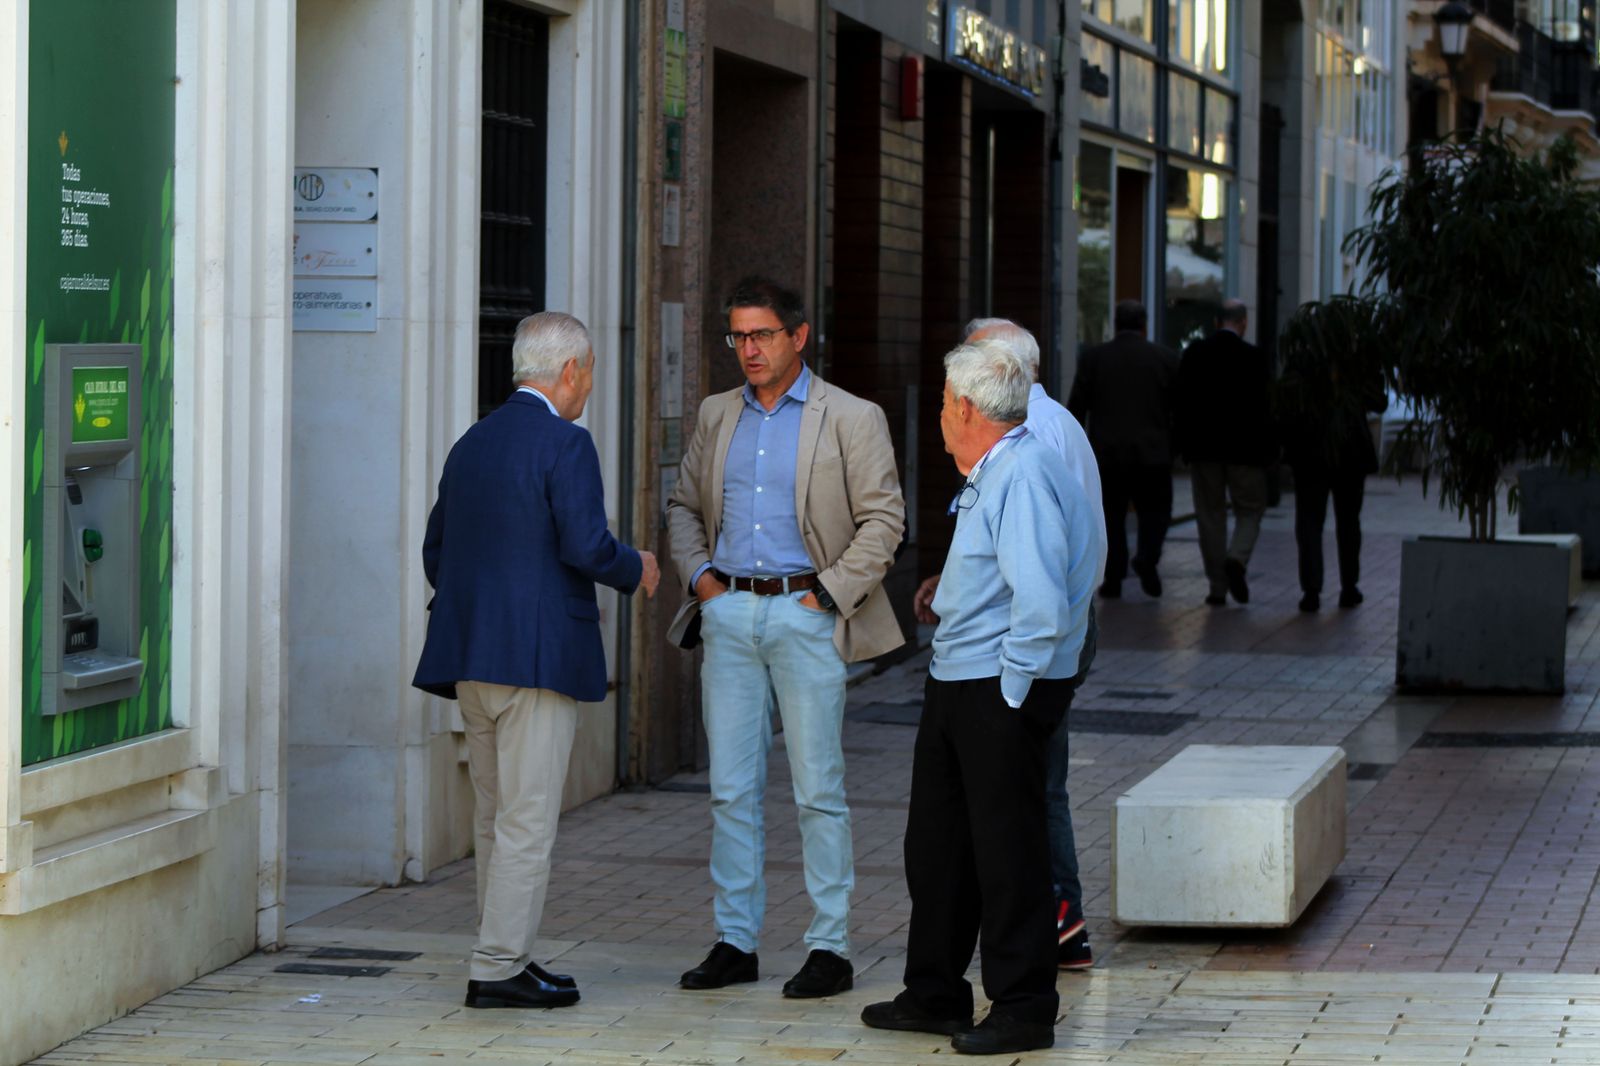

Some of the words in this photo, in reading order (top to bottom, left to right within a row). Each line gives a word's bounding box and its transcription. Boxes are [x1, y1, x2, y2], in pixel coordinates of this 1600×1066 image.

[62, 163, 80, 181] Todas
[61, 186, 72, 203] tus
[73, 187, 110, 208] operaciones,
[61, 207, 70, 224] 24
[71, 207, 89, 228] horas,
[61, 229, 73, 246] 365
[60, 273, 110, 294] cajaruraldelsur.es
